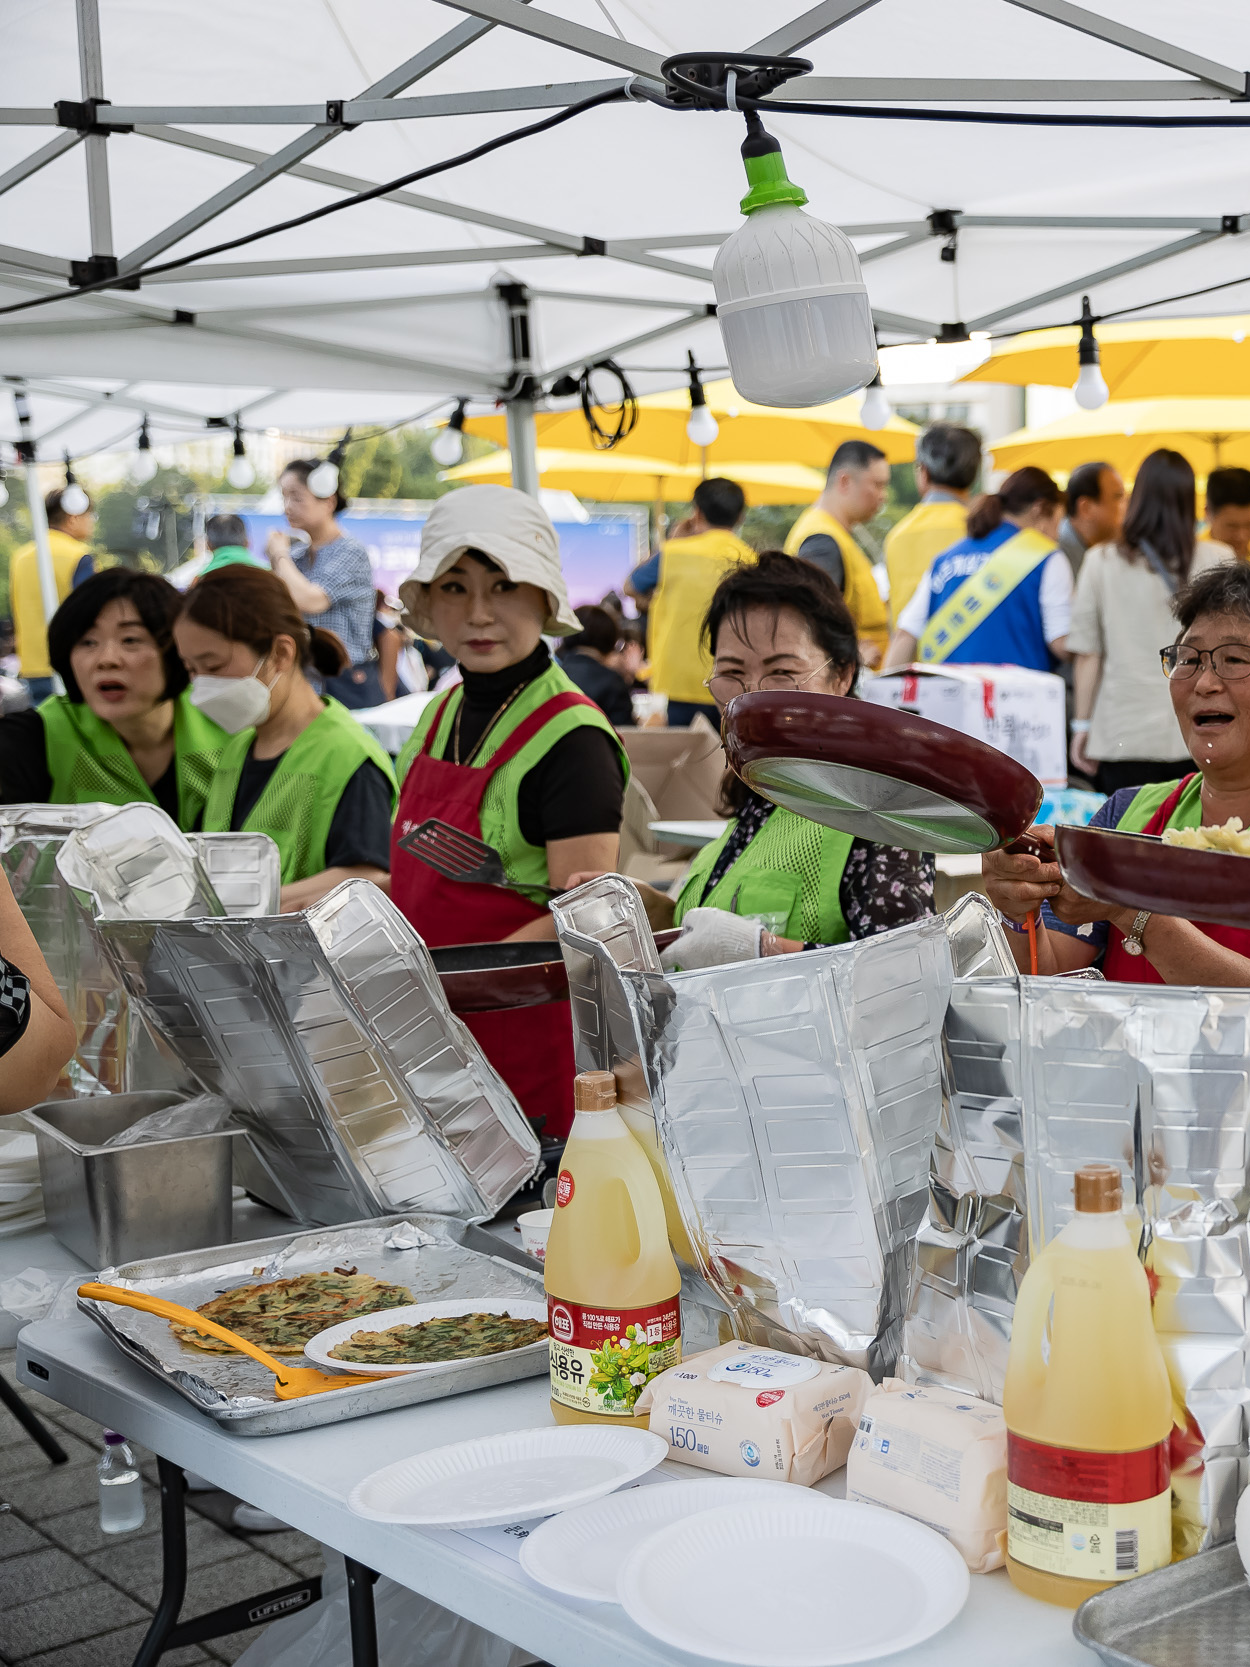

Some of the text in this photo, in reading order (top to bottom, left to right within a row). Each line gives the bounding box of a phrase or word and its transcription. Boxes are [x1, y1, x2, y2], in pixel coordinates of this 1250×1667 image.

[554, 1316, 570, 1331] 해표
[604, 1323, 621, 1331] 식용유
[550, 1350, 585, 1385] 식용유
[668, 1403, 724, 1426] 깨끗한 물티슈
